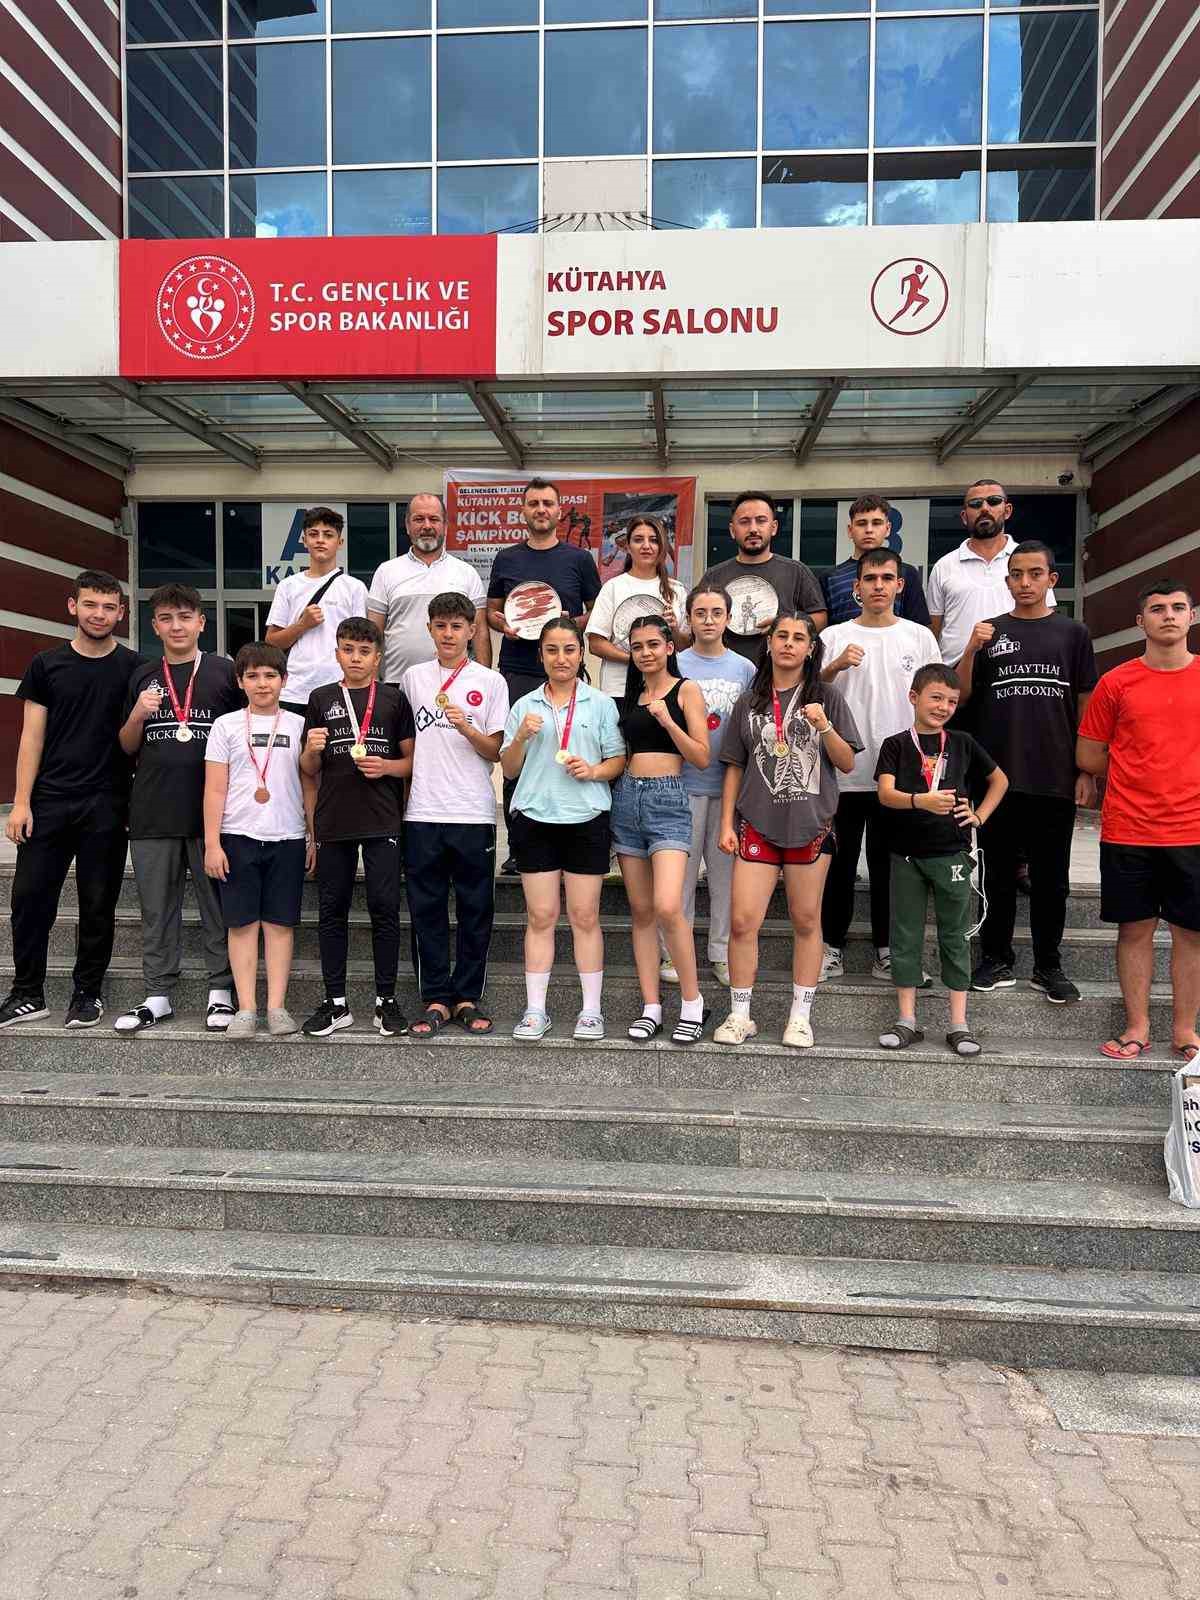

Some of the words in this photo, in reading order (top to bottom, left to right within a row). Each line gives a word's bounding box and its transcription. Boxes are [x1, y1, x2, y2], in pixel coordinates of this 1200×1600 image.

[547, 267, 667, 292] KÜTAHYA
[270, 283, 313, 302] T.C.
[322, 280, 429, 307] GENÇLİK
[439, 281, 469, 301] VE
[270, 312, 332, 331] SPOR
[339, 306, 469, 331] BAKANLIĞI
[547, 310, 634, 337] SPOR
[643, 307, 778, 335] SALONU
[998, 663, 1061, 677] MUAYTHAI
[996, 685, 1065, 700] KICKBOXING
[151, 708, 211, 719] MUAHAI
[334, 726, 385, 737] MUAHAI
[951, 864, 966, 882] K
